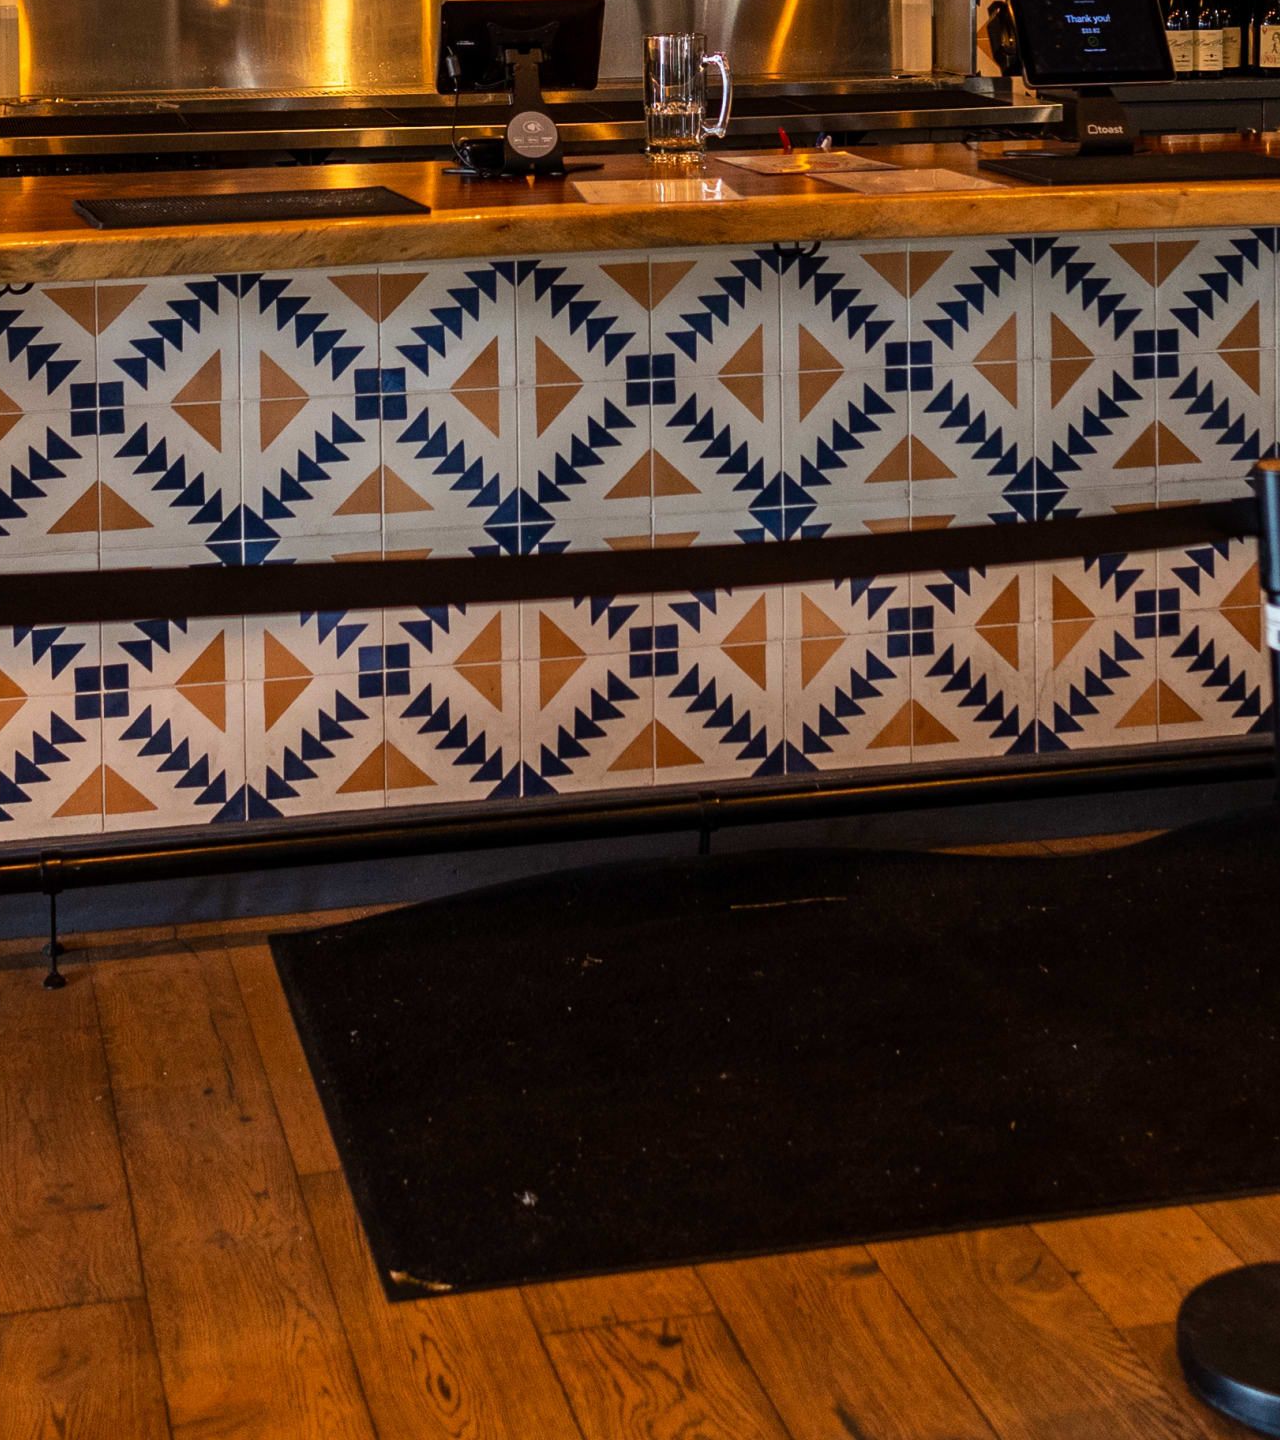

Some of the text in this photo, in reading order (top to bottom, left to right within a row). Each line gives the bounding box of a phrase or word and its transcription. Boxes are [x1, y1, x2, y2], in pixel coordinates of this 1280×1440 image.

[1065, 14, 1111, 24] Thank you!
[1098, 125, 1123, 134] toast
